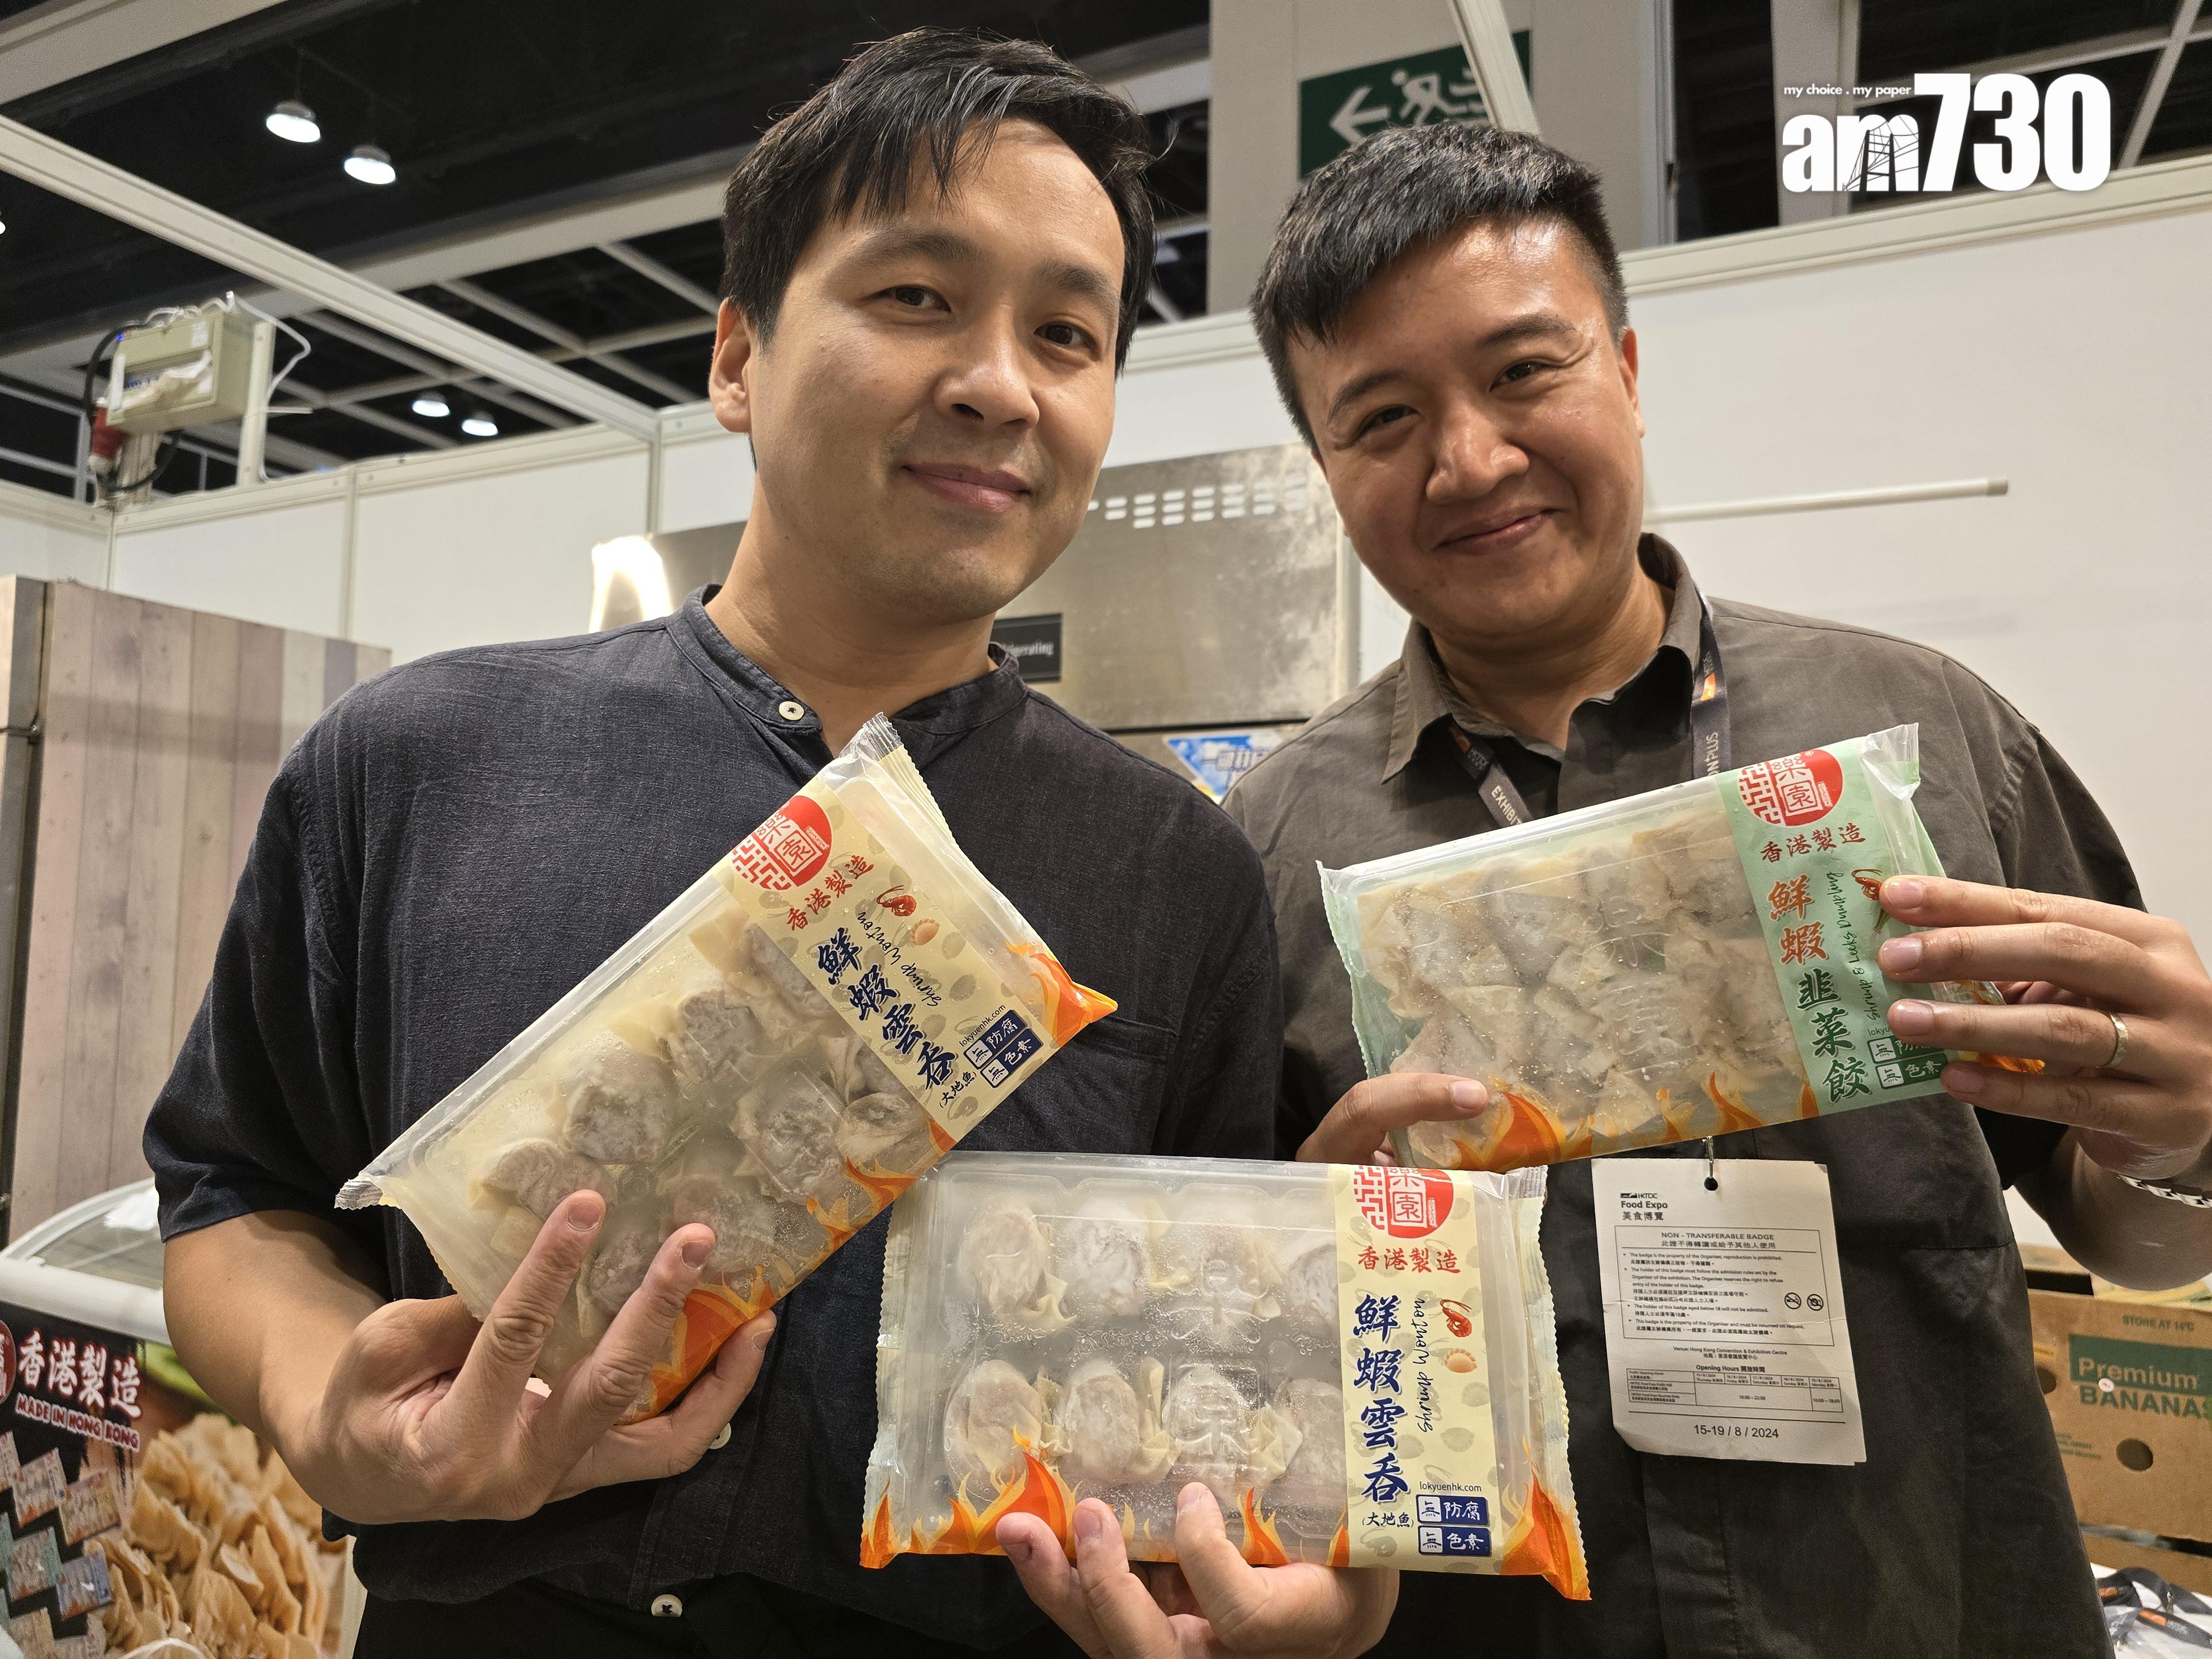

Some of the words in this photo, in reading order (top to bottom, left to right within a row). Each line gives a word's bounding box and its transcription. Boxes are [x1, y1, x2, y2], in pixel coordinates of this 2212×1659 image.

[1491, 785, 1522, 825] EXHIBIT
[1760, 822, 1866, 863] 香港製造
[786, 854, 874, 931] 香港製造
[1826, 872, 1852, 928] Dumpling
[901, 963, 942, 1007] Shrimp
[1768, 875, 1871, 1102] 鮮蝦韭菜餃
[1859, 979, 1880, 1020] Shrimp
[818, 927, 958, 1089] 鮮蝦雲吞
[959, 1004, 1006, 1047] lokyuenhk.com
[1622, 1211, 1664, 1221] 美食博覽
[1645, 1201, 1668, 1210] Expo
[1358, 1245, 1461, 1274] 香港製造
[1411, 1298, 1430, 1365] Wonton
[18, 1329, 142, 1418] 香港製造
[2078, 1357, 2198, 1390] Premium
[17, 1392, 51, 1423] MADE
[52, 1405, 66, 1428] IN
[67, 1410, 102, 1439] HONG
[1353, 1294, 1409, 1504] 鮮蝦雲吞
[1415, 1371, 1433, 1433] Shrimp
[1694, 1425, 1724, 1435] 15-19
[1751, 1427, 1780, 1438] 2024
[1420, 1481, 1482, 1493] lokyuenhk.com
[1421, 1500, 1480, 1521] 無防腐
[1423, 1532, 1485, 1551] 無色素
